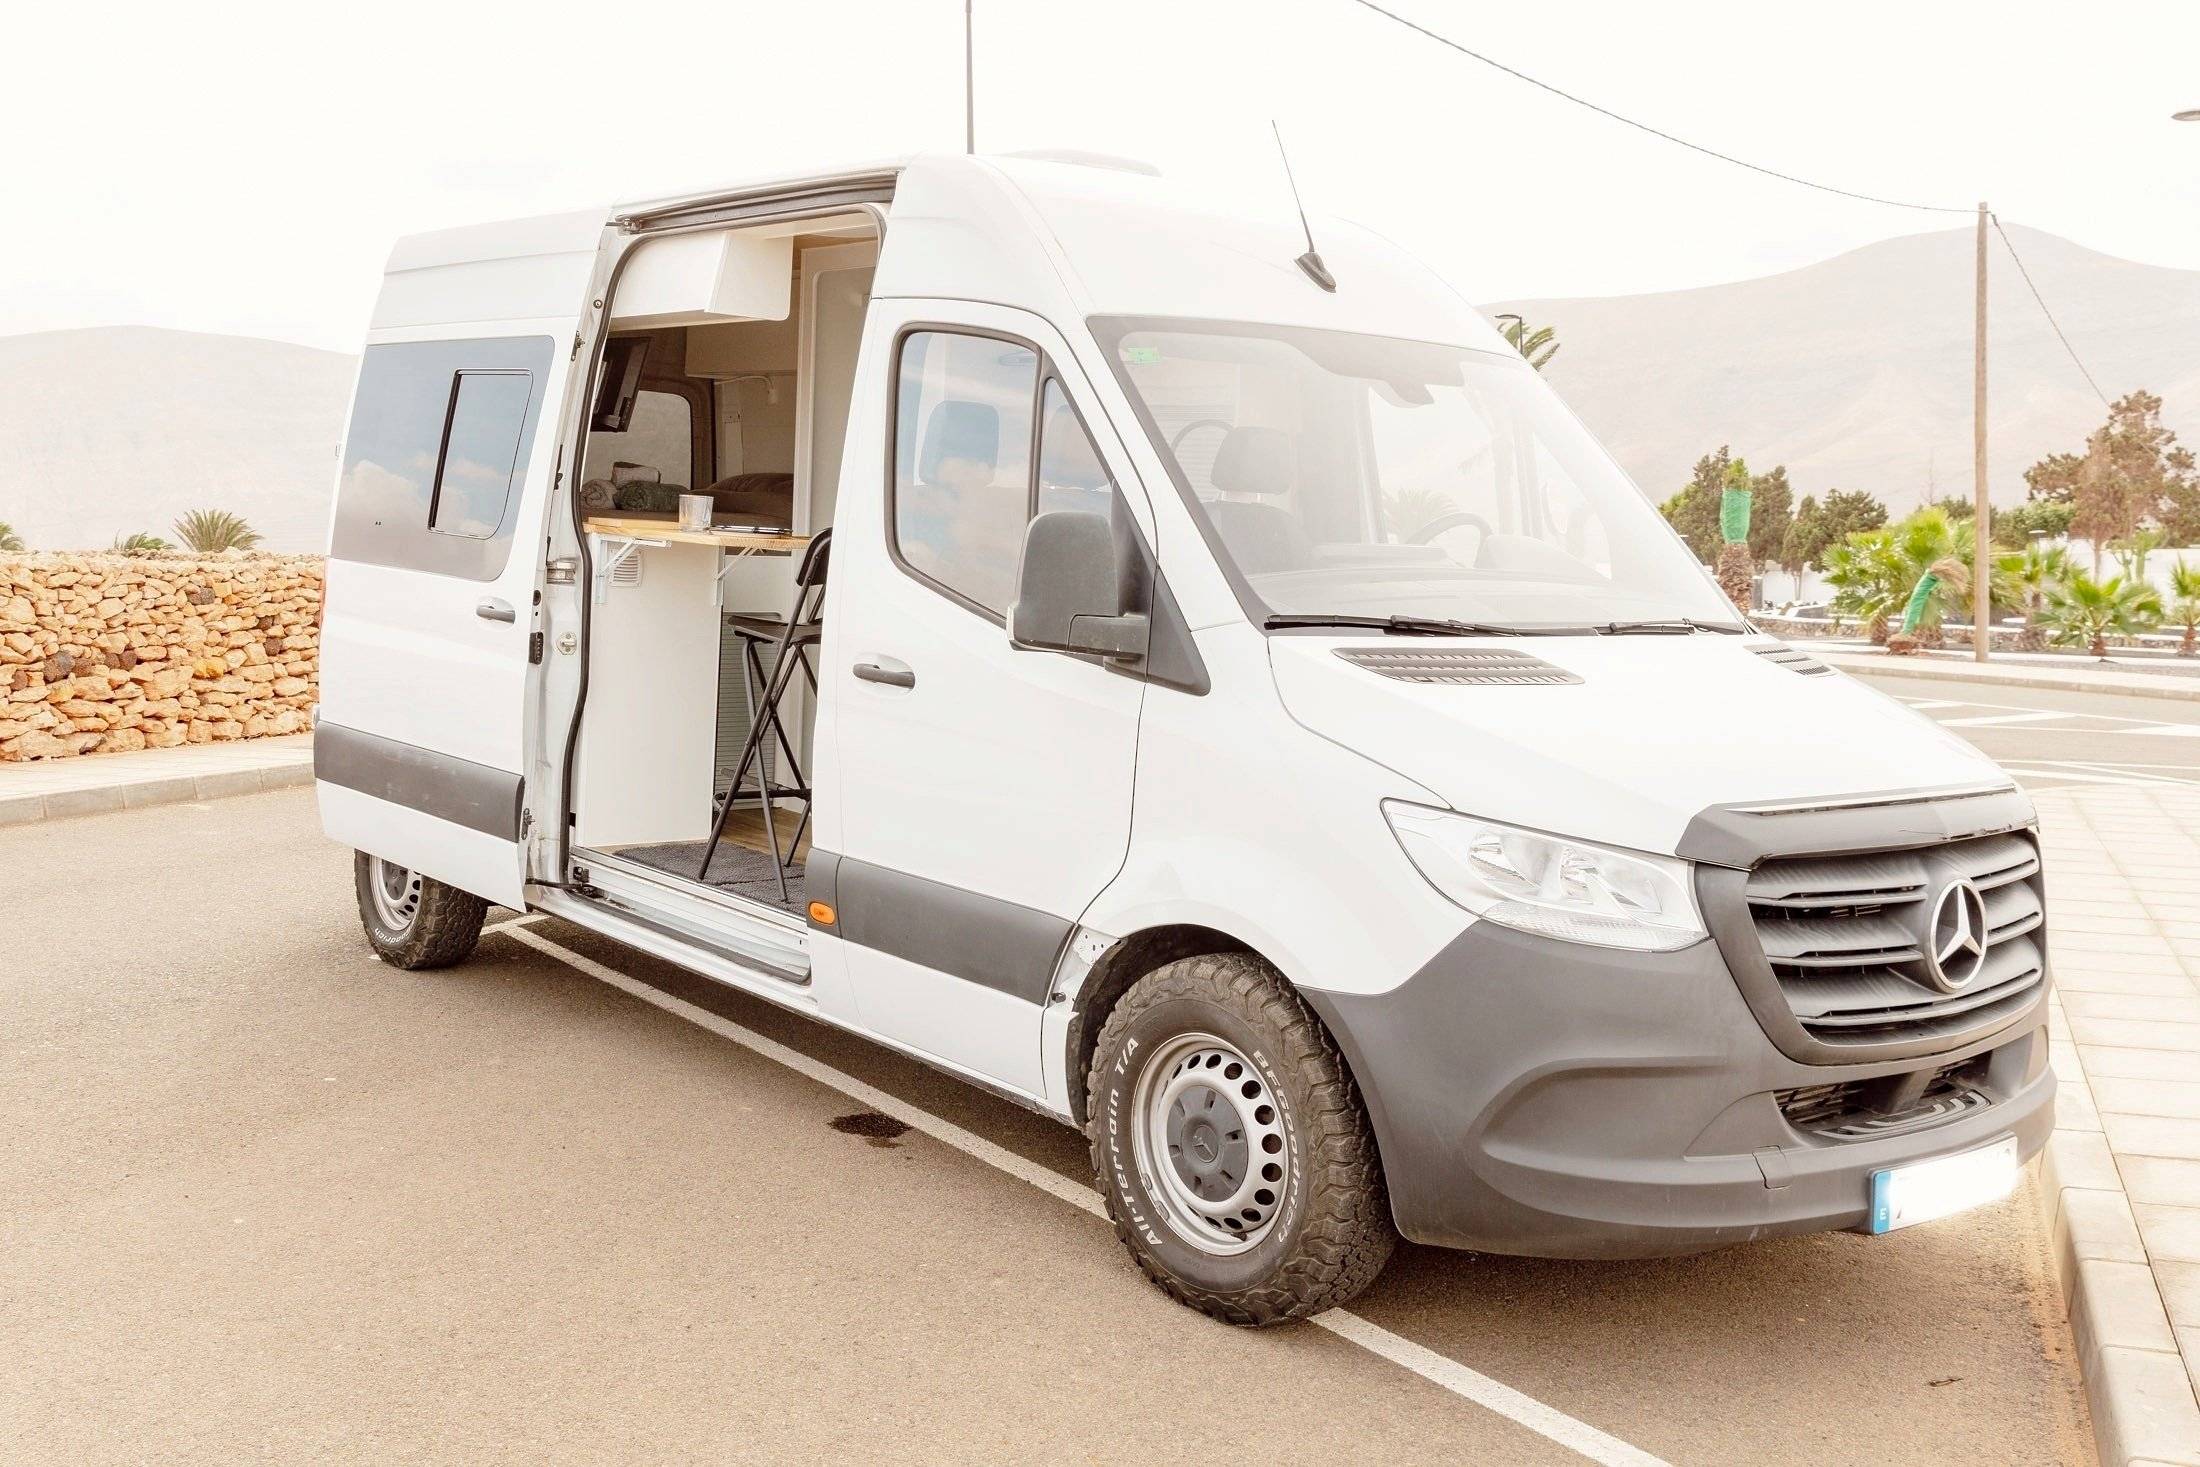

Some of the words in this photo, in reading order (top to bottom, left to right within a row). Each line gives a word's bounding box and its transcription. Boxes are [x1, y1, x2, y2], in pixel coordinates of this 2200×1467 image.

[1114, 1038, 1139, 1075] T/A
[1108, 1088, 1163, 1245] All-Terrain
[1253, 1050, 1300, 1242] BFGoodrich
[1880, 1207, 1887, 1220] E
